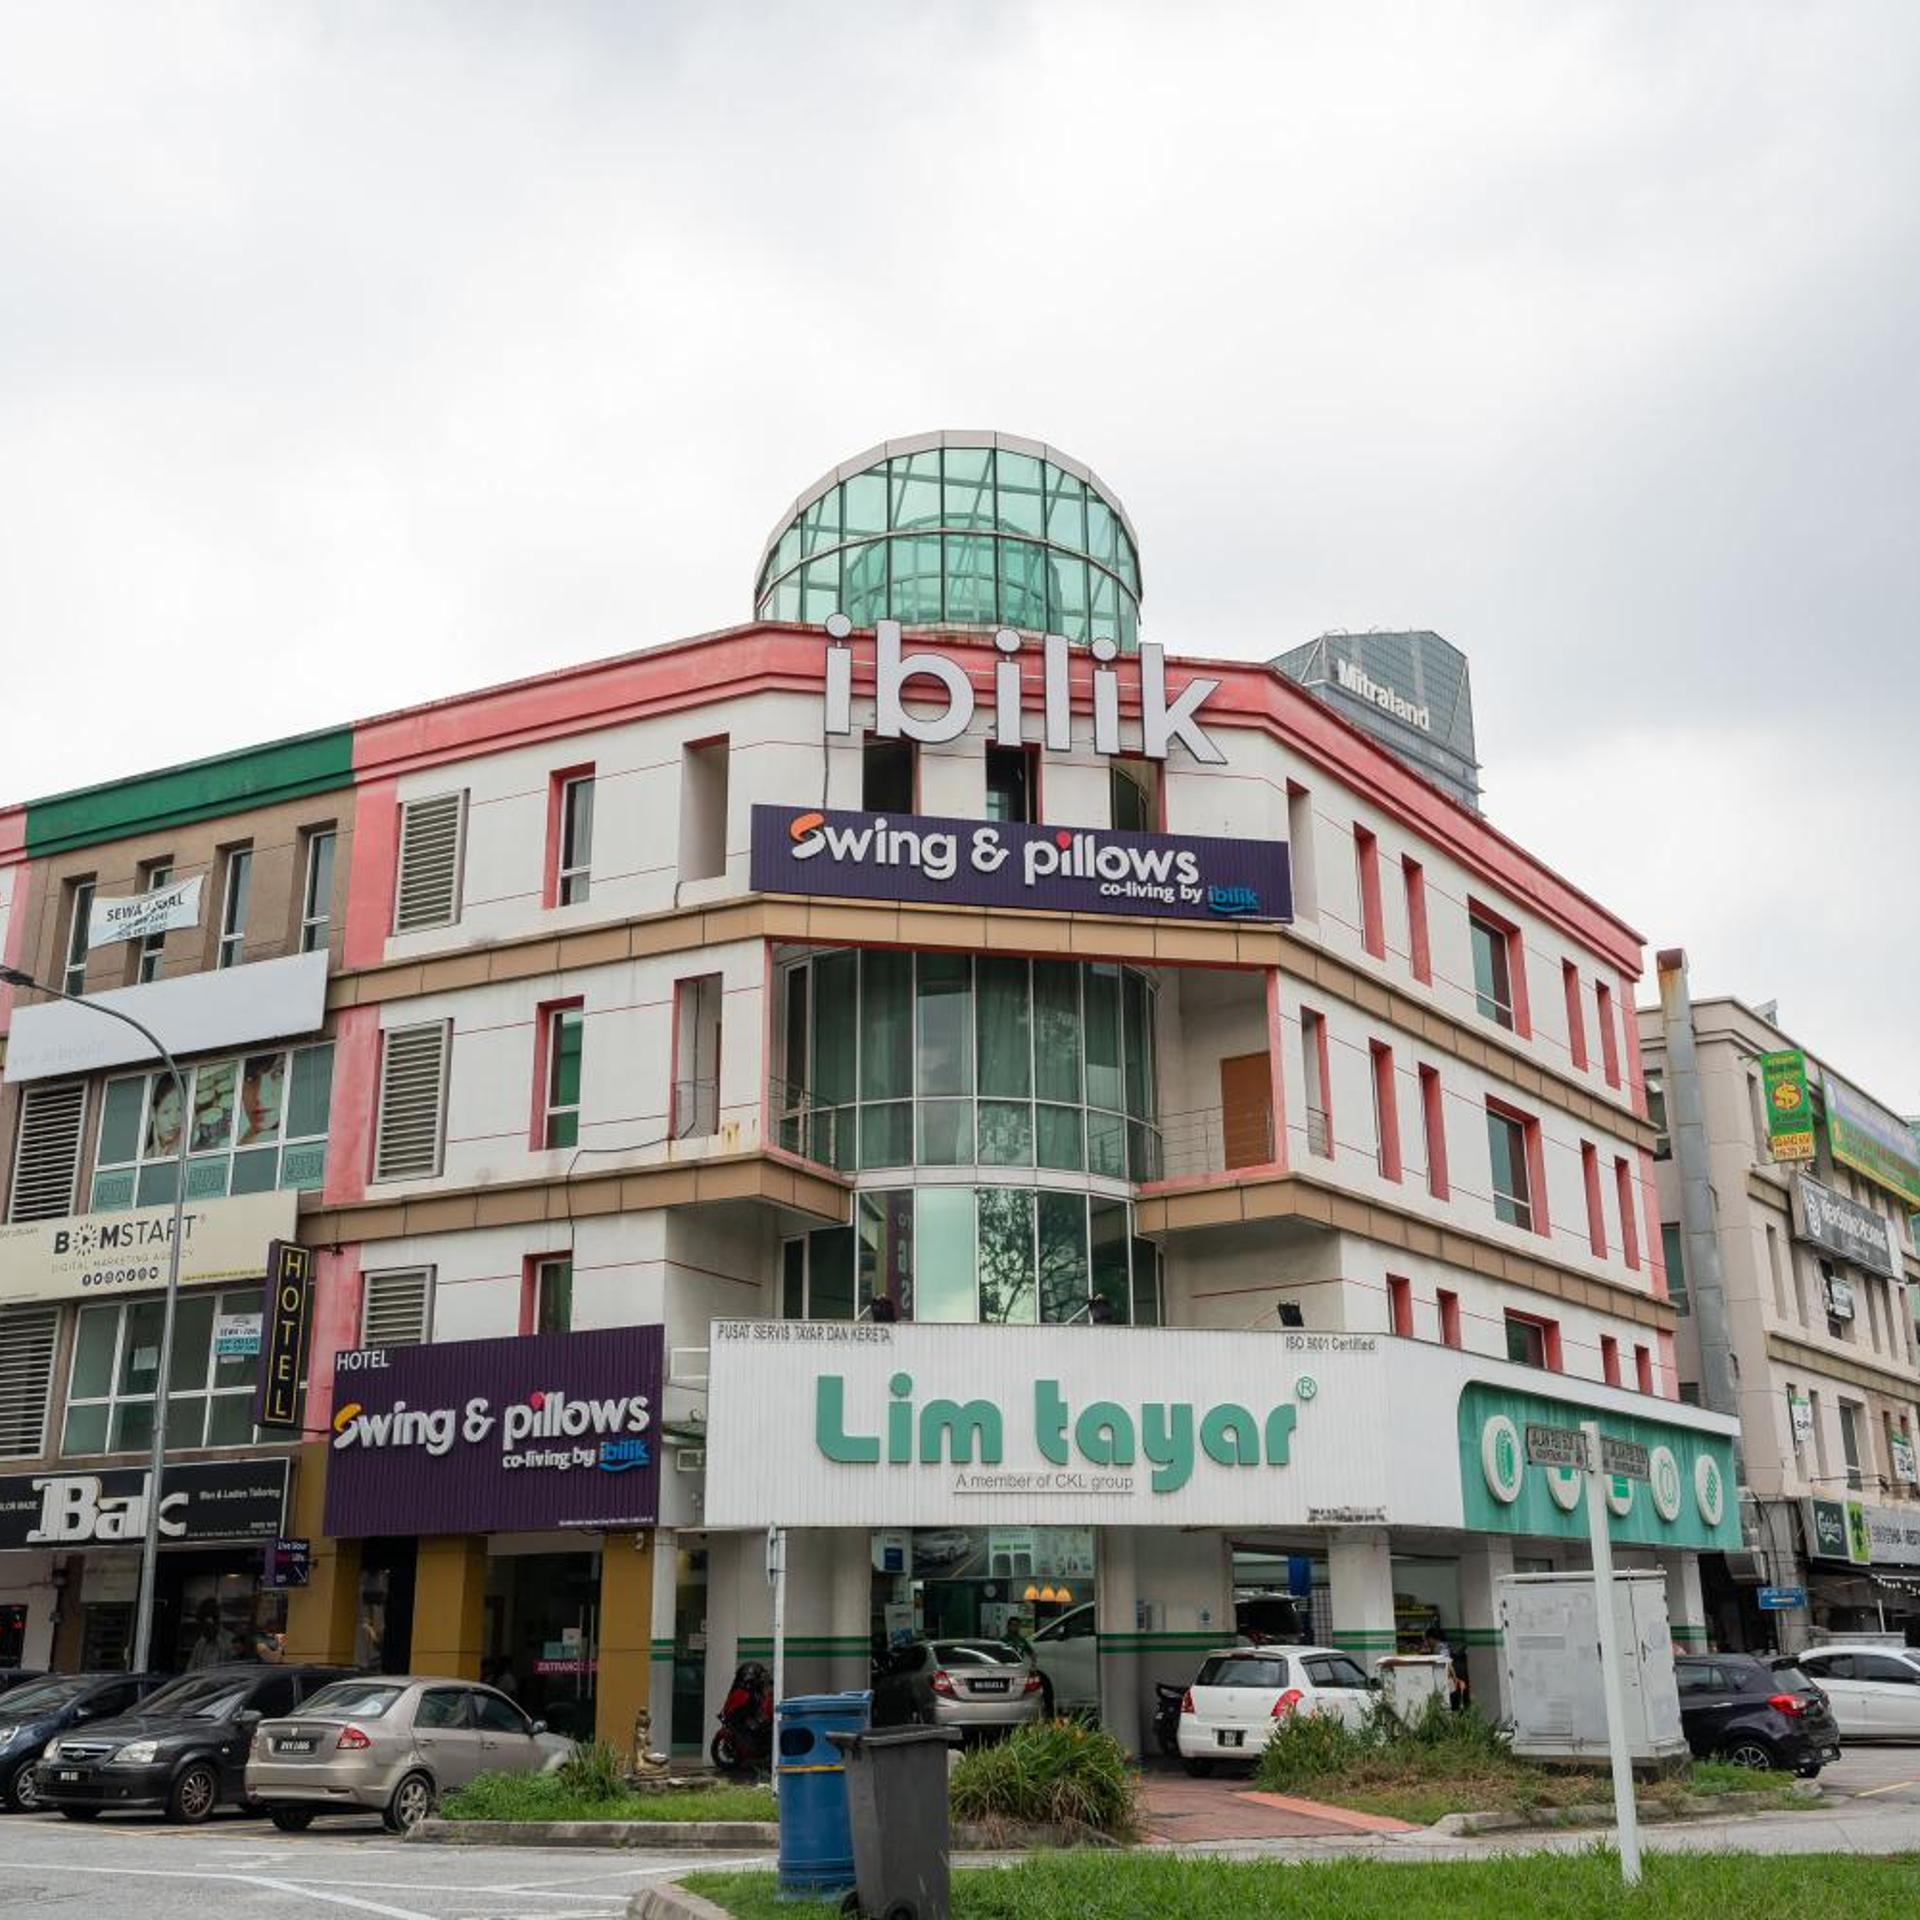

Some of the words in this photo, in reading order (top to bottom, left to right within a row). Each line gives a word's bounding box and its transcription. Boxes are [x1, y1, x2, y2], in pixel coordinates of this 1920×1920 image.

[825, 613, 1228, 764] ibilik
[1338, 658, 1429, 731] Mitraland
[789, 811, 957, 880] Swing
[971, 827, 1009, 873] &
[1024, 830, 1199, 885] pillows
[1100, 881, 1176, 903] co-living
[1180, 885, 1202, 904] by
[1208, 886, 1258, 906] ibilik
[106, 903, 142, 922] SEWA
[275, 1253, 302, 1416] HOTEL
[718, 1323, 750, 1340] PUSAT
[753, 1324, 789, 1340] SERVIS
[794, 1325, 823, 1341] TAYAR
[827, 1326, 848, 1341] DAN
[850, 1326, 890, 1342] KERETA
[1286, 1335, 1304, 1349] ISO
[1332, 1336, 1375, 1350] Certified
[337, 1349, 390, 1371] HOTEL
[333, 1400, 455, 1456] Swing
[463, 1397, 496, 1442] &
[503, 1390, 650, 1454] pillows
[816, 1372, 1003, 1464] Lim
[1035, 1379, 1297, 1493] tayar
[502, 1447, 570, 1470] co-living
[572, 1446, 595, 1468] by
[599, 1440, 649, 1463] ibilik
[955, 1474, 966, 1488] A
[971, 1473, 1030, 1488] member
[1036, 1473, 1050, 1488] of
[1055, 1474, 1086, 1488] CKL
[1091, 1475, 1133, 1491] group
